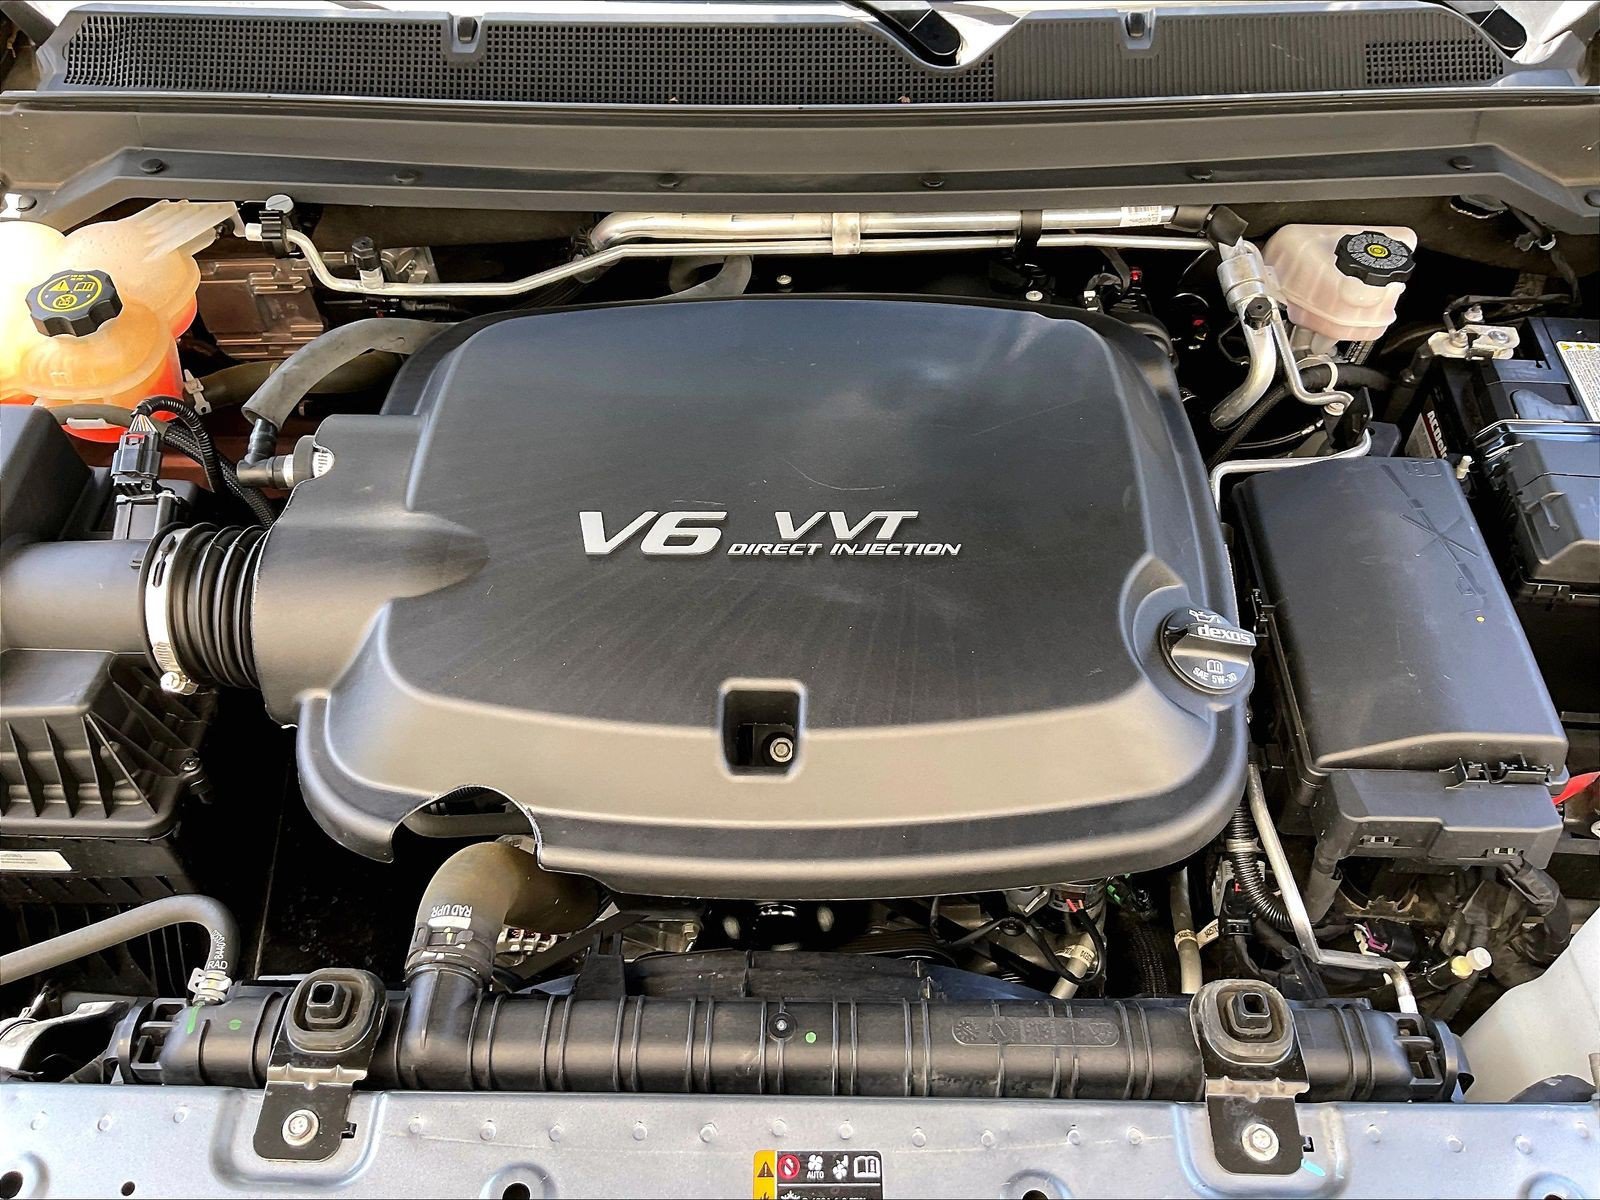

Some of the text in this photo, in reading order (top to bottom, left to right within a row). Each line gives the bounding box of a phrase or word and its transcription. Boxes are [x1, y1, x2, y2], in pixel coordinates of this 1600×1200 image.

[579, 511, 728, 555] V6
[774, 510, 919, 541] VVT
[727, 542, 962, 556] DIRECT INJECTION
[1197, 624, 1251, 644] dexos
[1192, 666, 1237, 685] SAE 5W-30
[431, 904, 473, 917] RAD UPR
[206, 960, 228, 970] RAD
[806, 1170, 824, 1180] AUTO
